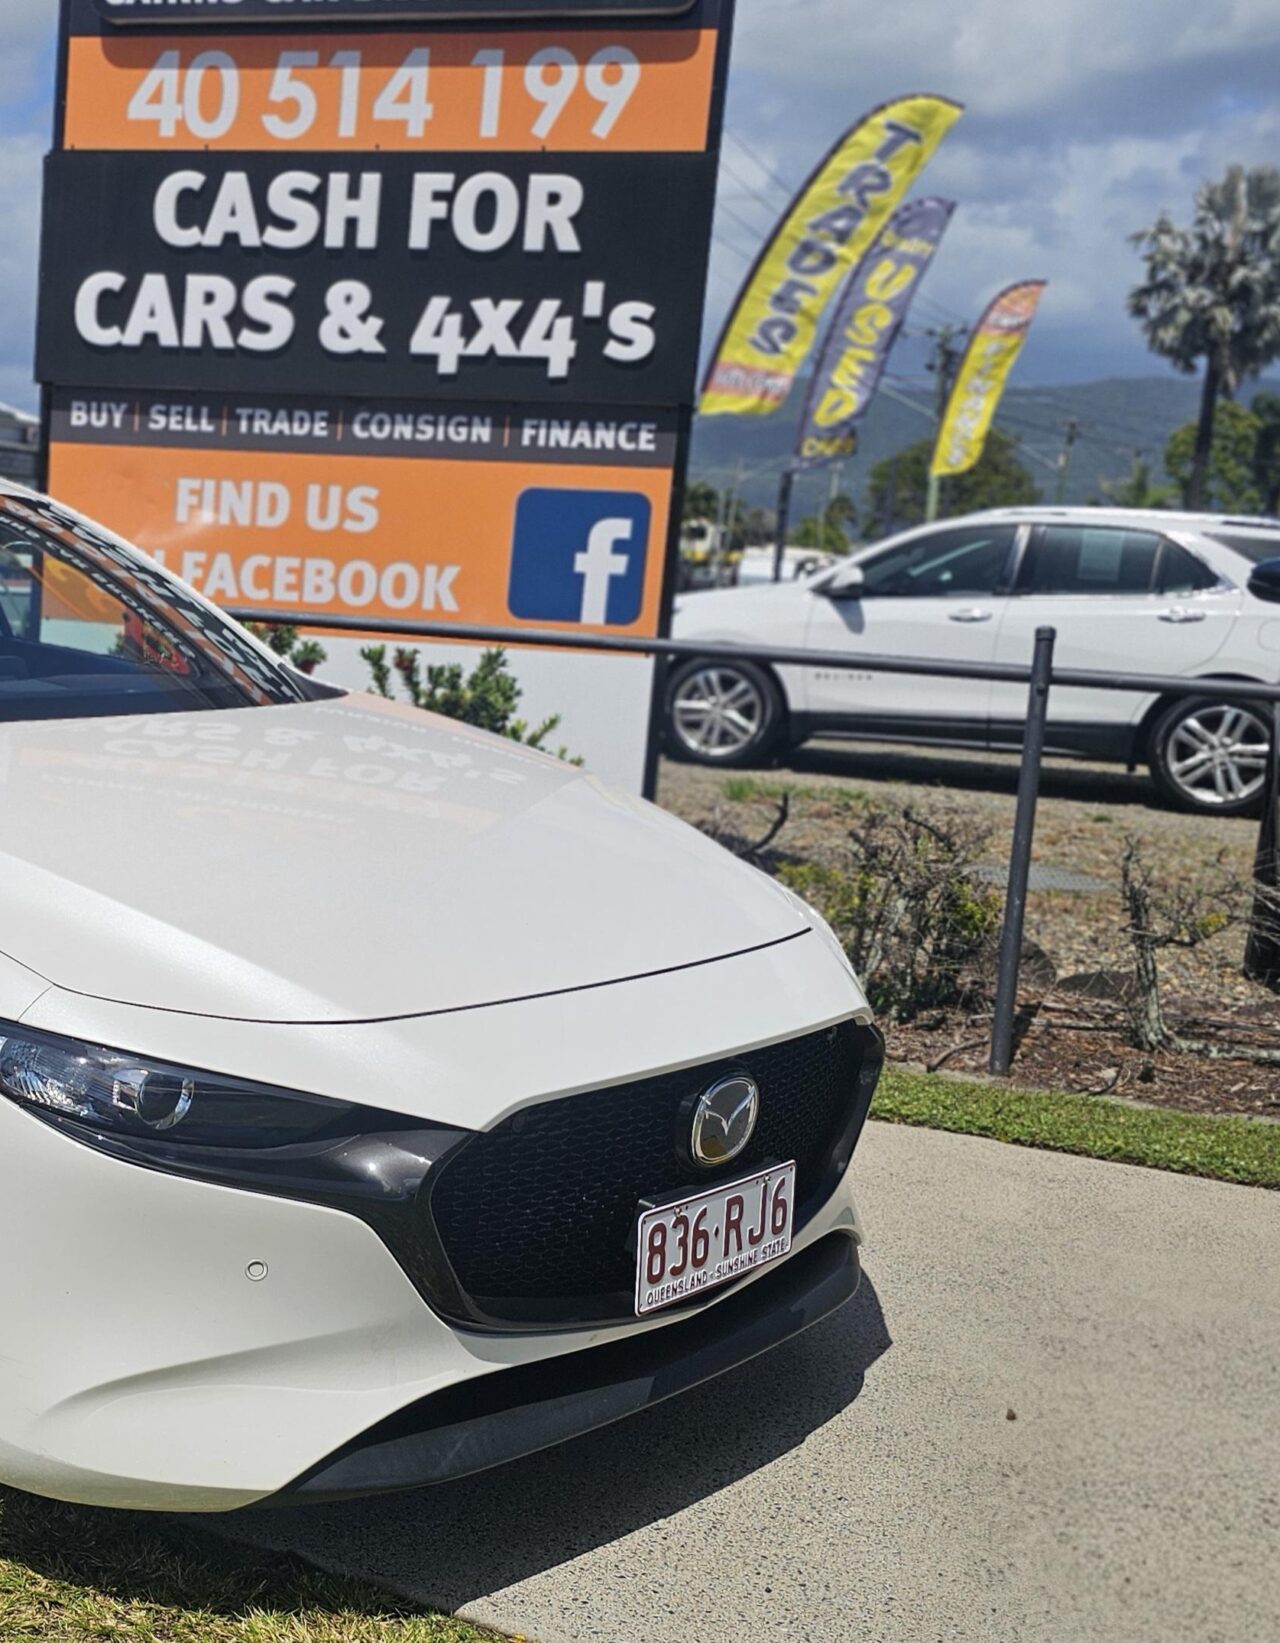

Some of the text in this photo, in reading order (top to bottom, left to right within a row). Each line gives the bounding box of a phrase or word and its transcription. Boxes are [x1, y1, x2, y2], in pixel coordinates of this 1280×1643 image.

[127, 45, 642, 141] 40 514 199
[153, 170, 584, 253] CASH FOR
[748, 120, 924, 357] TRADES
[74, 271, 297, 351] CARS
[318, 280, 387, 355] &
[813, 257, 918, 427] USED
[70, 401, 657, 452] BUY SELL TRADE CONSIGN FINANCE
[174, 477, 381, 534] FIND US
[182, 551, 462, 614] FACEBOOK
[646, 1270, 708, 1306] QUEENSLAND
[715, 1252, 759, 1278] SUNSHINE
[760, 1238, 787, 1261] STATE
